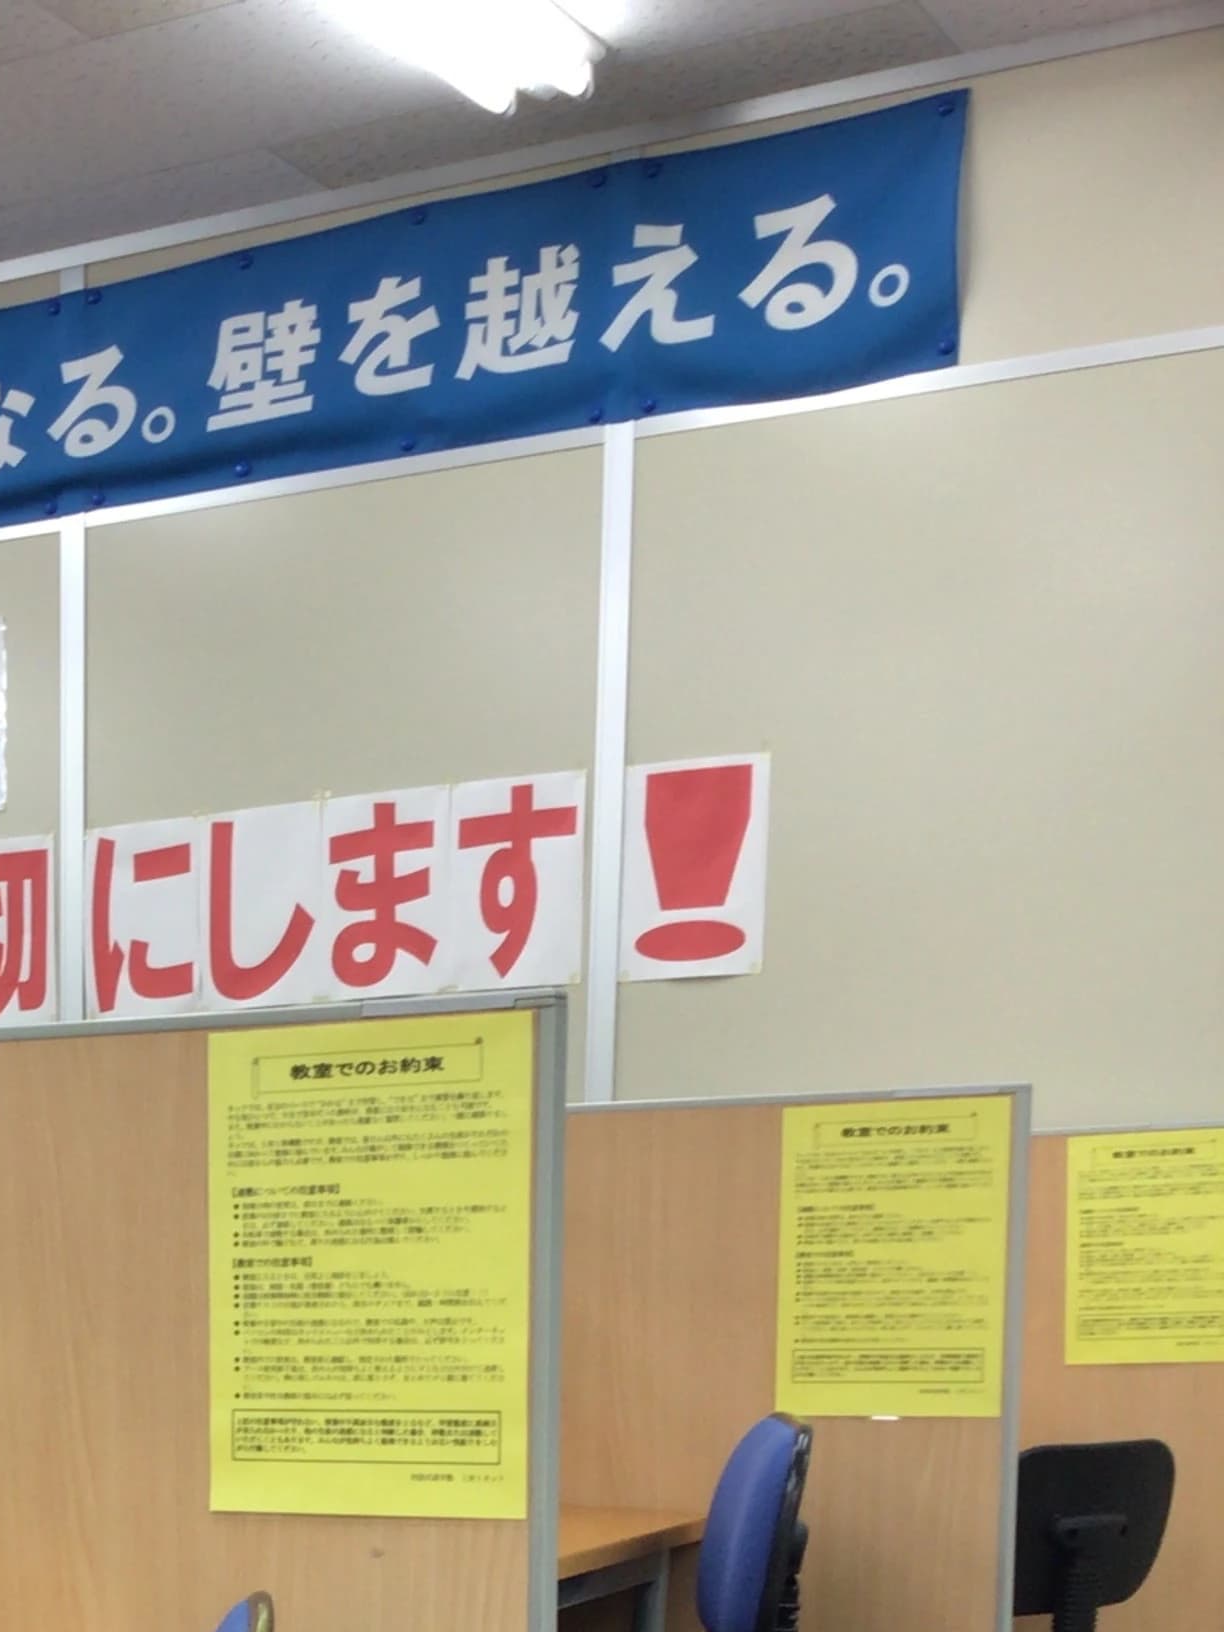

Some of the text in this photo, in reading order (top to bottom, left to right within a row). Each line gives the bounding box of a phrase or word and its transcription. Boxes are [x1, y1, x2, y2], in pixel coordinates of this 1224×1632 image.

[290, 1055, 445, 1081] 教室でのお約束
